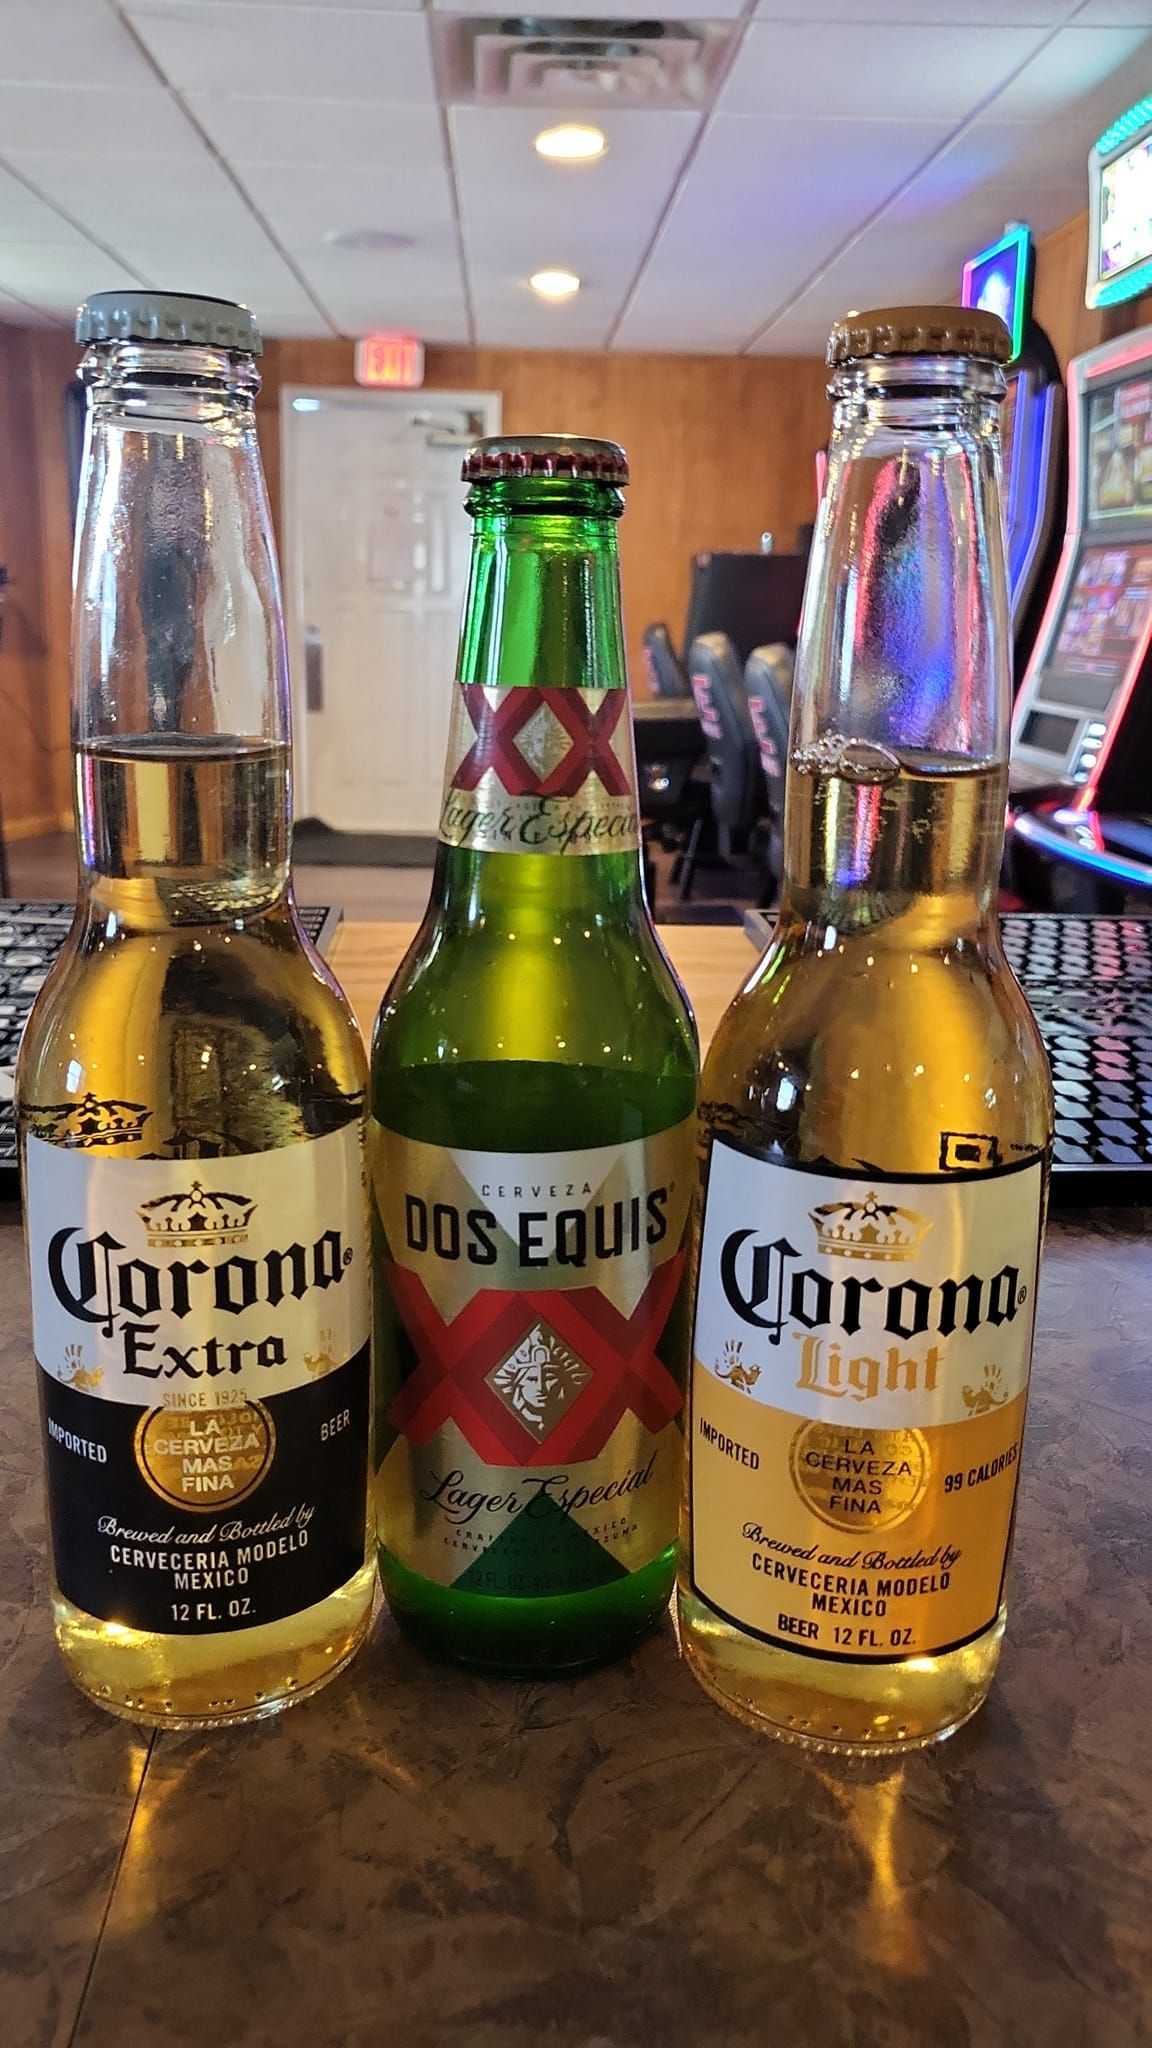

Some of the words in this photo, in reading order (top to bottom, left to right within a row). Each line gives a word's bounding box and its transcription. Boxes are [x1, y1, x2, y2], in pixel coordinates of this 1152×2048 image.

[482, 1181, 593, 1199] CERVEZA
[405, 1193, 498, 1266] DOS
[518, 1186, 668, 1268] EQUIS
[48, 1227, 346, 1338] Corona
[720, 1229, 1020, 1345] Corona
[119, 1320, 288, 1379] Extra
[792, 1331, 945, 1402] Light
[162, 1392, 207, 1408] SINCE
[214, 1389, 248, 1406] 1925
[47, 1416, 107, 1465] IMPORTED
[189, 1419, 221, 1436] LA
[320, 1408, 350, 1441] BEER
[153, 1433, 260, 1455] CERVEZA
[699, 1416, 760, 1470] IMPORTED
[844, 1438, 875, 1455] LA
[182, 1456, 233, 1474] MAS
[805, 1451, 912, 1476] CERVEZA
[944, 1471, 963, 1493] 99
[967, 1442, 1018, 1487] CALORIES
[181, 1475, 235, 1493] FINA
[419, 1470, 524, 1525] Lager
[522, 1450, 658, 1521] Especial
[832, 1476, 882, 1495] MAS
[829, 1495, 882, 1514] FINA
[97, 1515, 173, 1544] Brewed
[175, 1524, 218, 1544] and
[218, 1510, 293, 1543] Bottled
[295, 1503, 315, 1529] by
[110, 1545, 230, 1570] CERVECERIA
[237, 1529, 309, 1563] MODELO
[742, 1522, 819, 1561] Brewed
[817, 1551, 860, 1569] and
[861, 1548, 939, 1571] Bottled
[939, 1545, 962, 1569] by
[174, 1568, 249, 1590] MEXICO
[752, 1553, 869, 1596] CERVECERIA
[876, 1572, 951, 1597] MODELO
[171, 1604, 189, 1621] 12
[196, 1603, 222, 1621] FL.
[229, 1597, 256, 1617] OZ.
[812, 1593, 887, 1617] MEXICO
[777, 1613, 820, 1640] BEER
[833, 1627, 852, 1646] 12
[858, 1630, 884, 1647] FL.
[890, 1628, 916, 1646] OZ.
